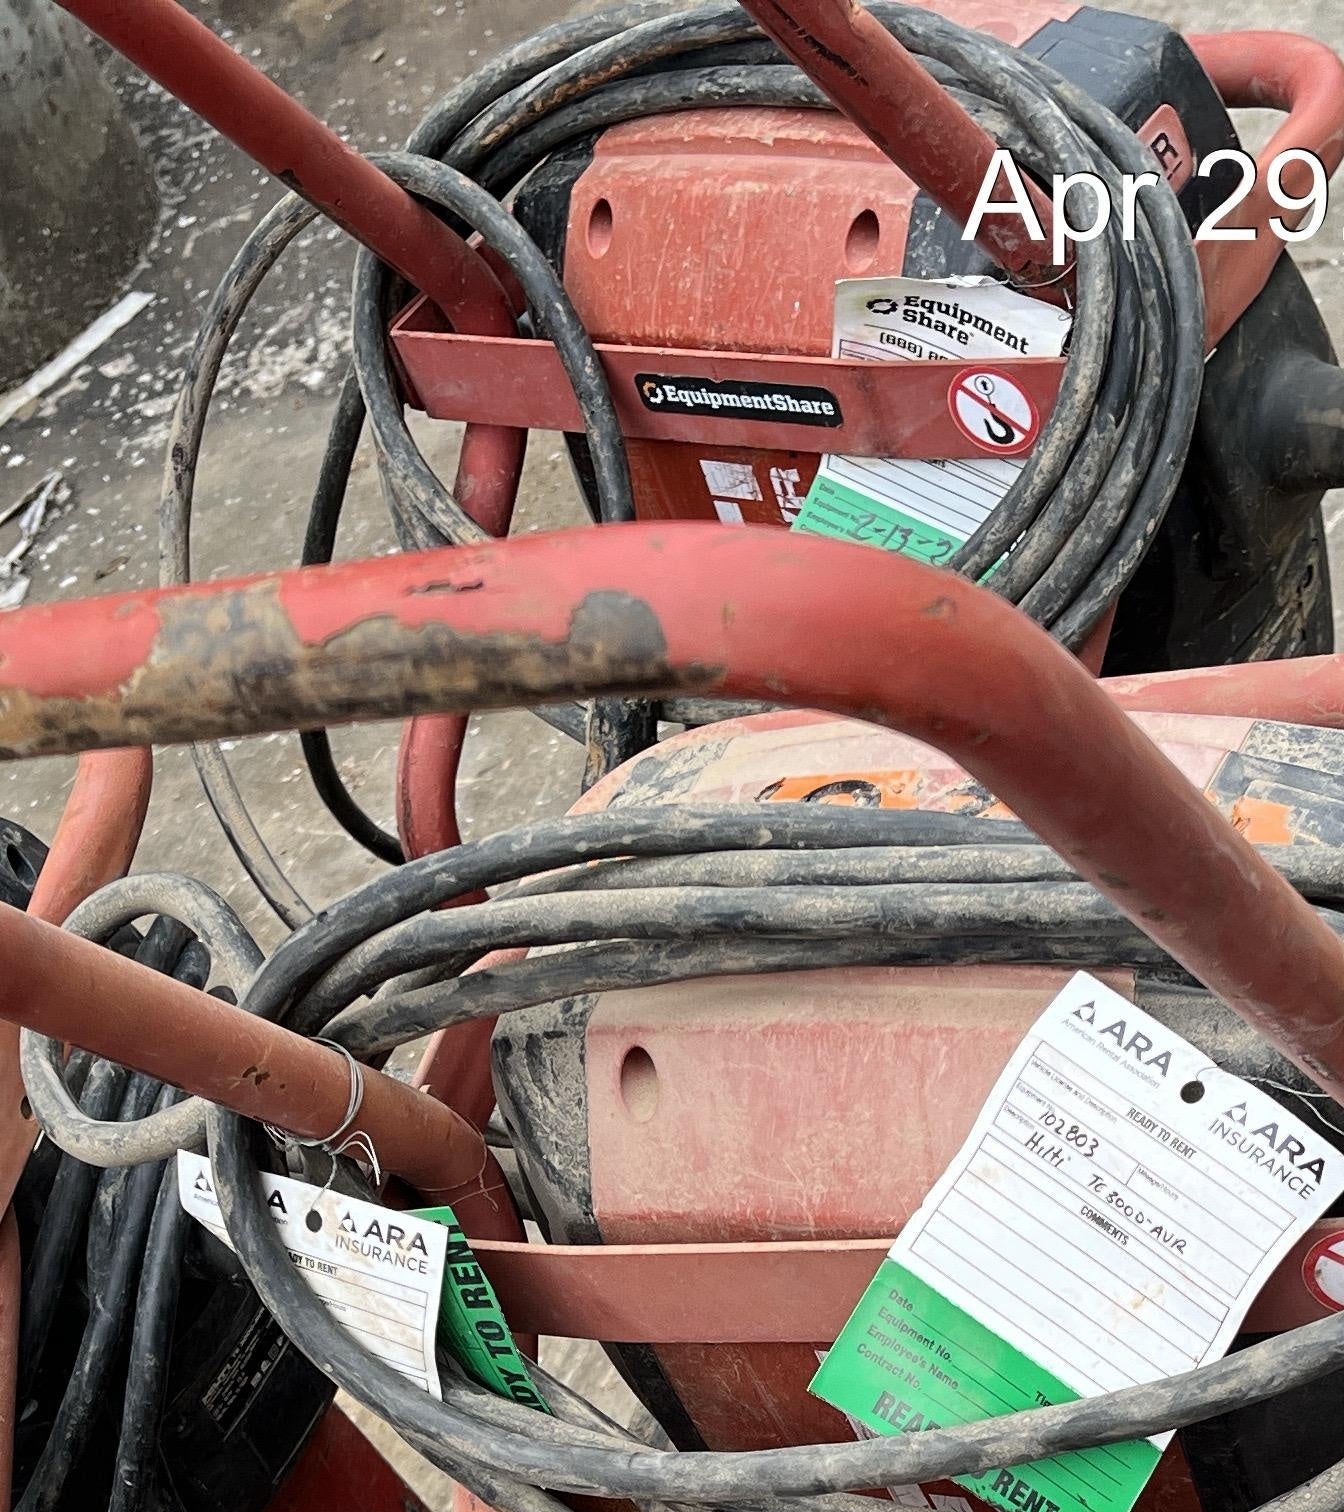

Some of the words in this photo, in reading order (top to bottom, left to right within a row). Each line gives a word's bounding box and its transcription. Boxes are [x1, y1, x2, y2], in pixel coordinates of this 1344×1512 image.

[902, 310, 970, 346] Share
[903, 295, 1030, 355] Equipment
[663, 384, 835, 416] EquipmentShare
[856, 512, 953, 565] 2-13-2
[1097, 1019, 1173, 1078] ARA
[1039, 1111, 1099, 1158] 102803
[1126, 1107, 1159, 1132] READY
[1157, 1128, 1171, 1141] TO
[1169, 1134, 1198, 1160] RENT
[1250, 1122, 1326, 1186] ARA
[1208, 1117, 1316, 1201] INSURANCE
[364, 1219, 429, 1257] ARA
[1080, 1205, 1130, 1247] COMMENTS
[317, 1260, 338, 1276] RENT
[334, 1234, 429, 1275] INSURANCE
[475, 1320, 515, 1360] TO
[867, 1324, 927, 1370] Employee's
[928, 1363, 960, 1391] Name
[877, 1306, 935, 1350] Equipment
[935, 1343, 953, 1363] No.
[888, 1289, 914, 1312] Date
[1035, 1390, 1054, 1408] Ti
[856, 1342, 905, 1379] Contract
[905, 1372, 923, 1391] No.
[871, 1390, 943, 1433] REA
